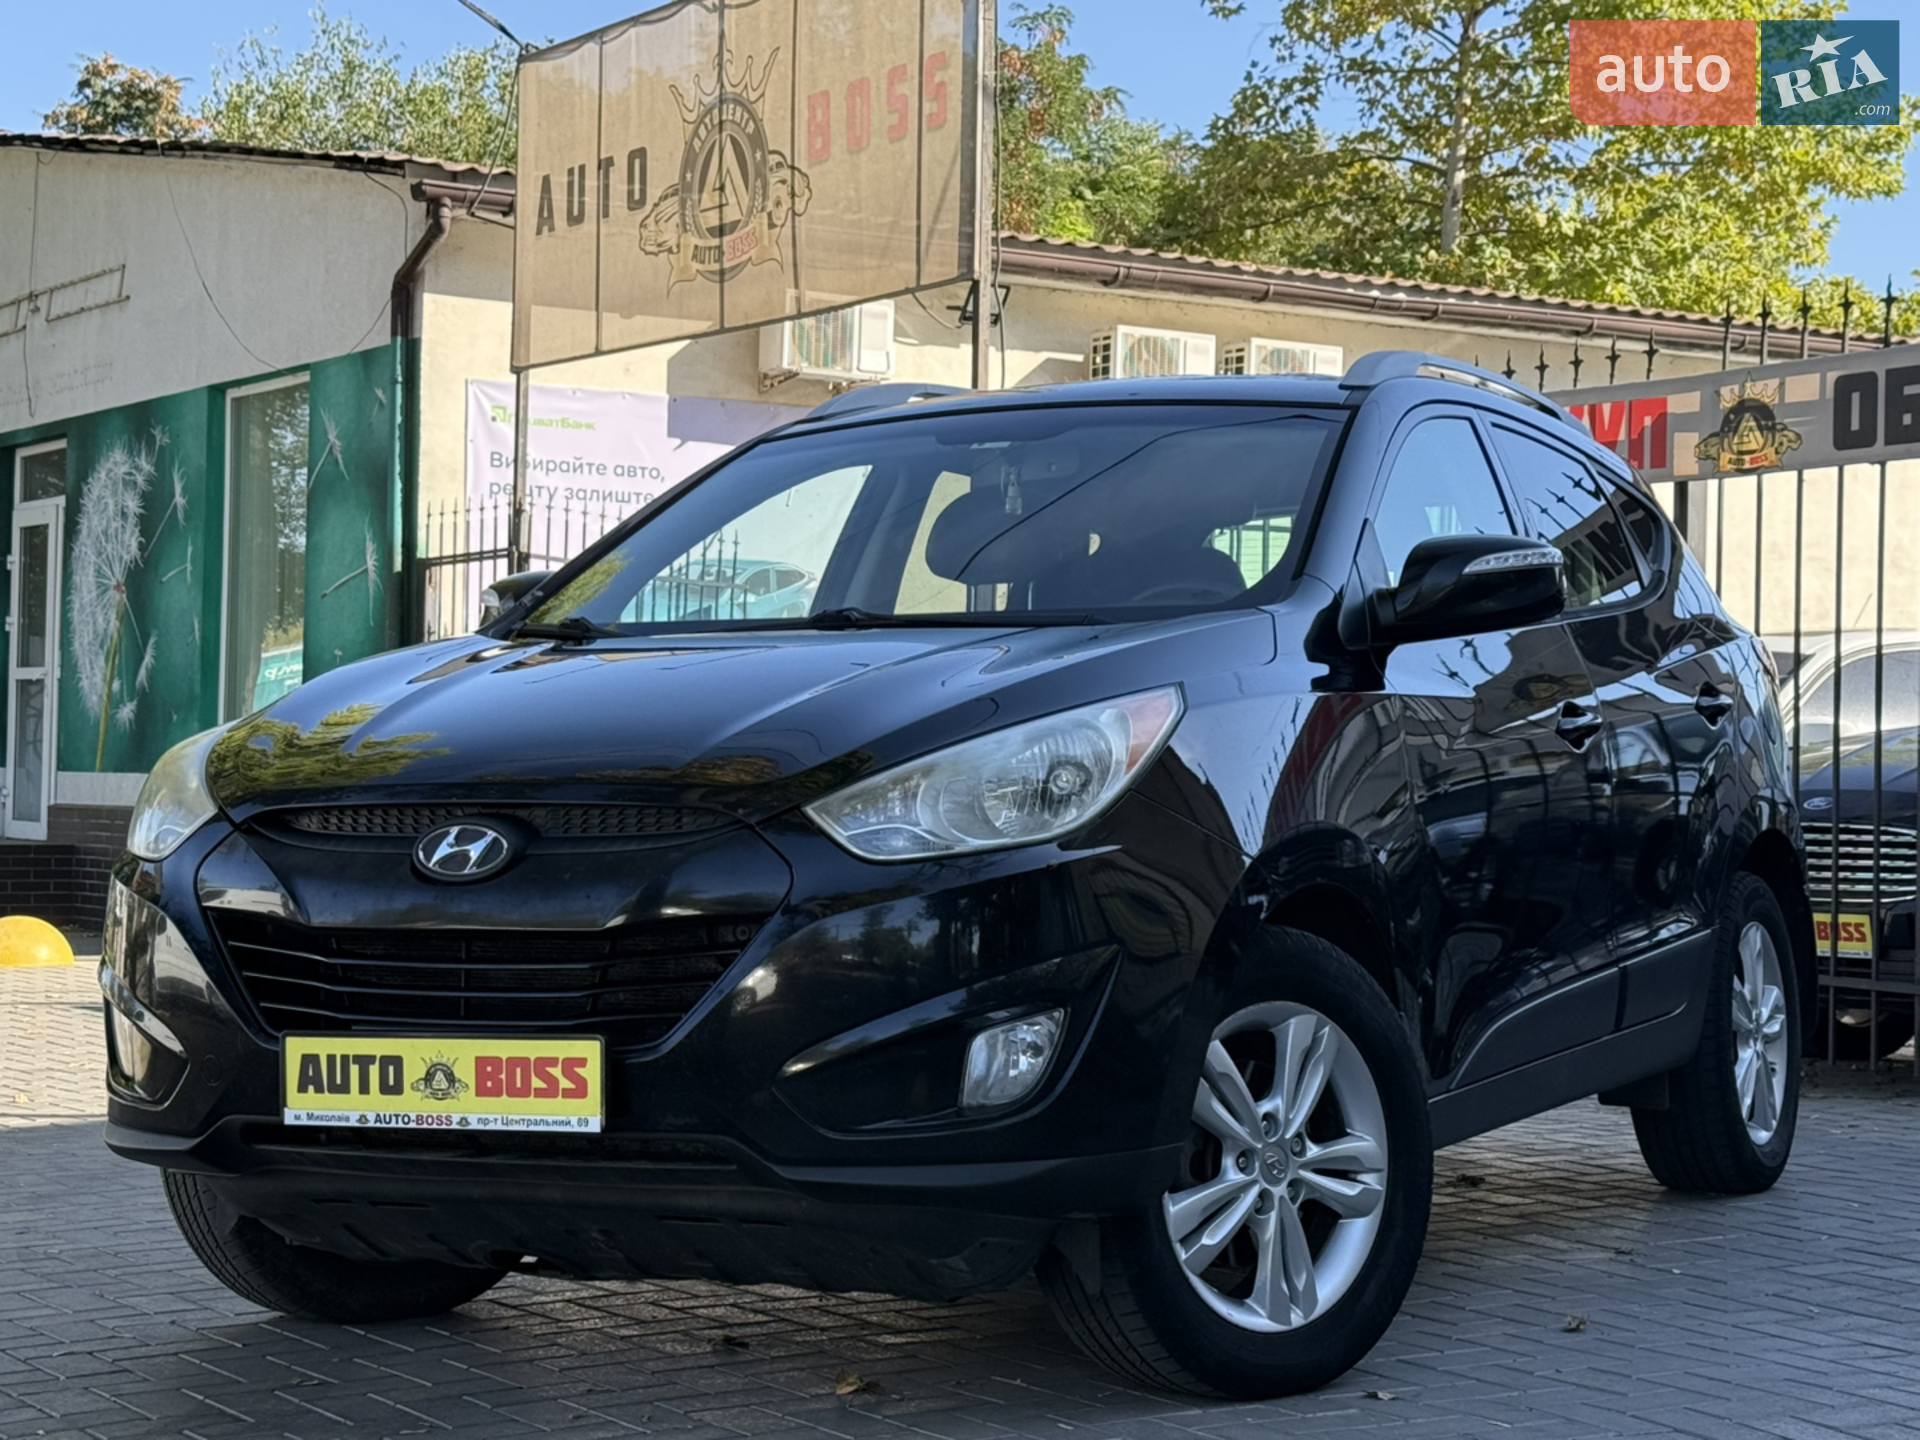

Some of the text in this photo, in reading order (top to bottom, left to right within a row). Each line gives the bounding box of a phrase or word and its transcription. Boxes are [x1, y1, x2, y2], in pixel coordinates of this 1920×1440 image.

[536, 51, 948, 236] AUTO BOSS
[507, 412, 596, 430] иватБанк
[1569, 396, 1668, 470] УП
[613, 464, 665, 482] авто,
[297, 1053, 589, 1099] AUTO BOSS
[374, 1113, 453, 1126] AUTO-BOSS
